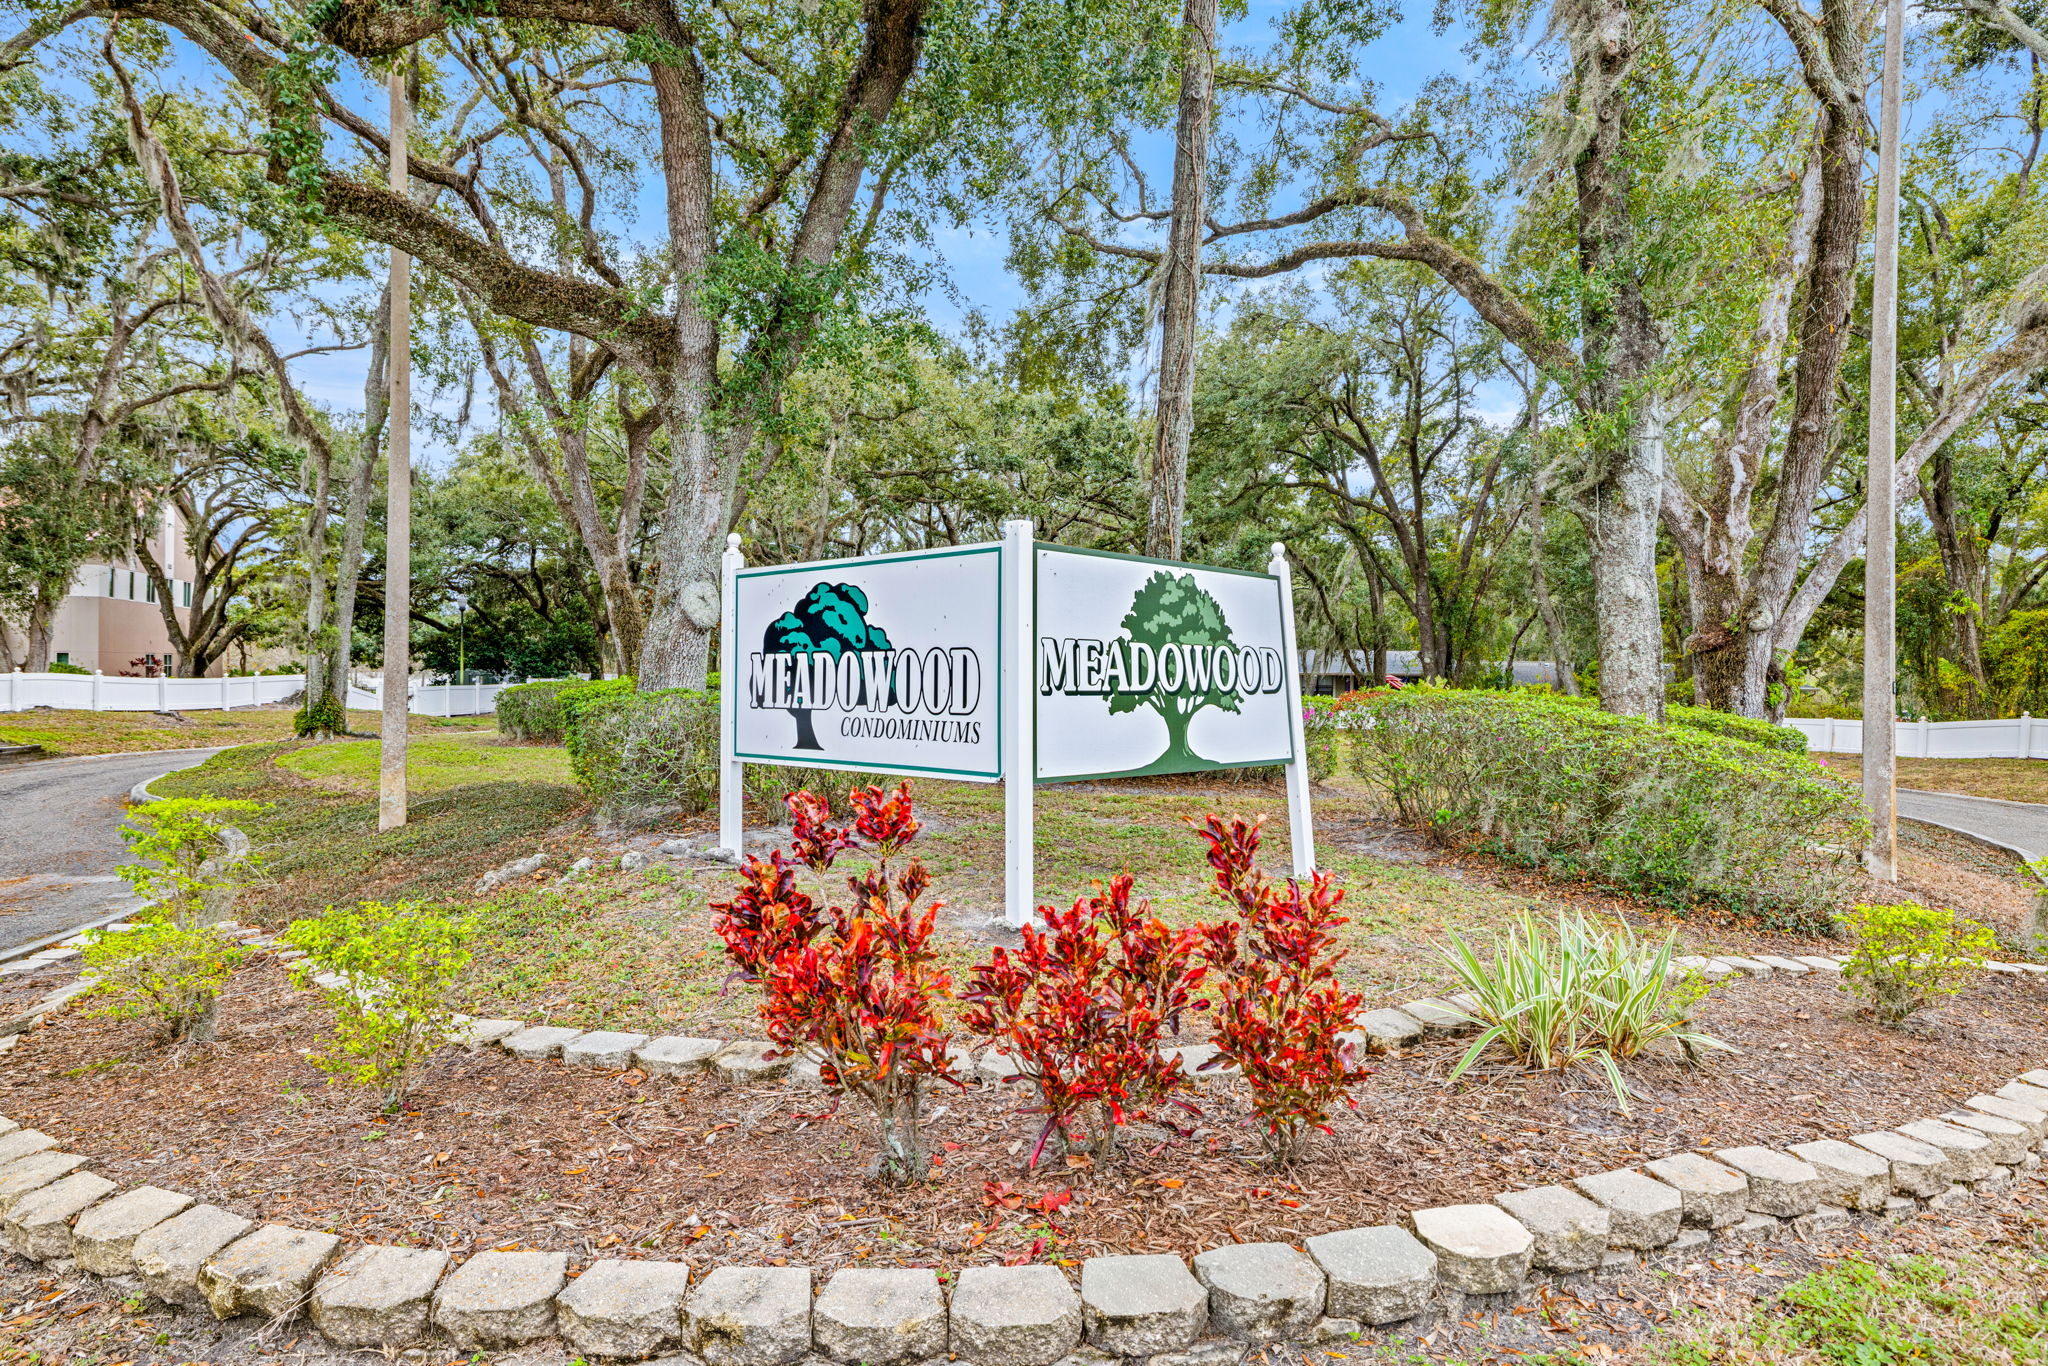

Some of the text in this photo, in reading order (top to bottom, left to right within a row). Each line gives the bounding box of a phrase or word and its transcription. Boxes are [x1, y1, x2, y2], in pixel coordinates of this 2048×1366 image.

[750, 647, 981, 715] MEADOWOOD
[1040, 637, 1282, 696] MEADOWOOD
[840, 716, 981, 744] CONDOMINIUMS
